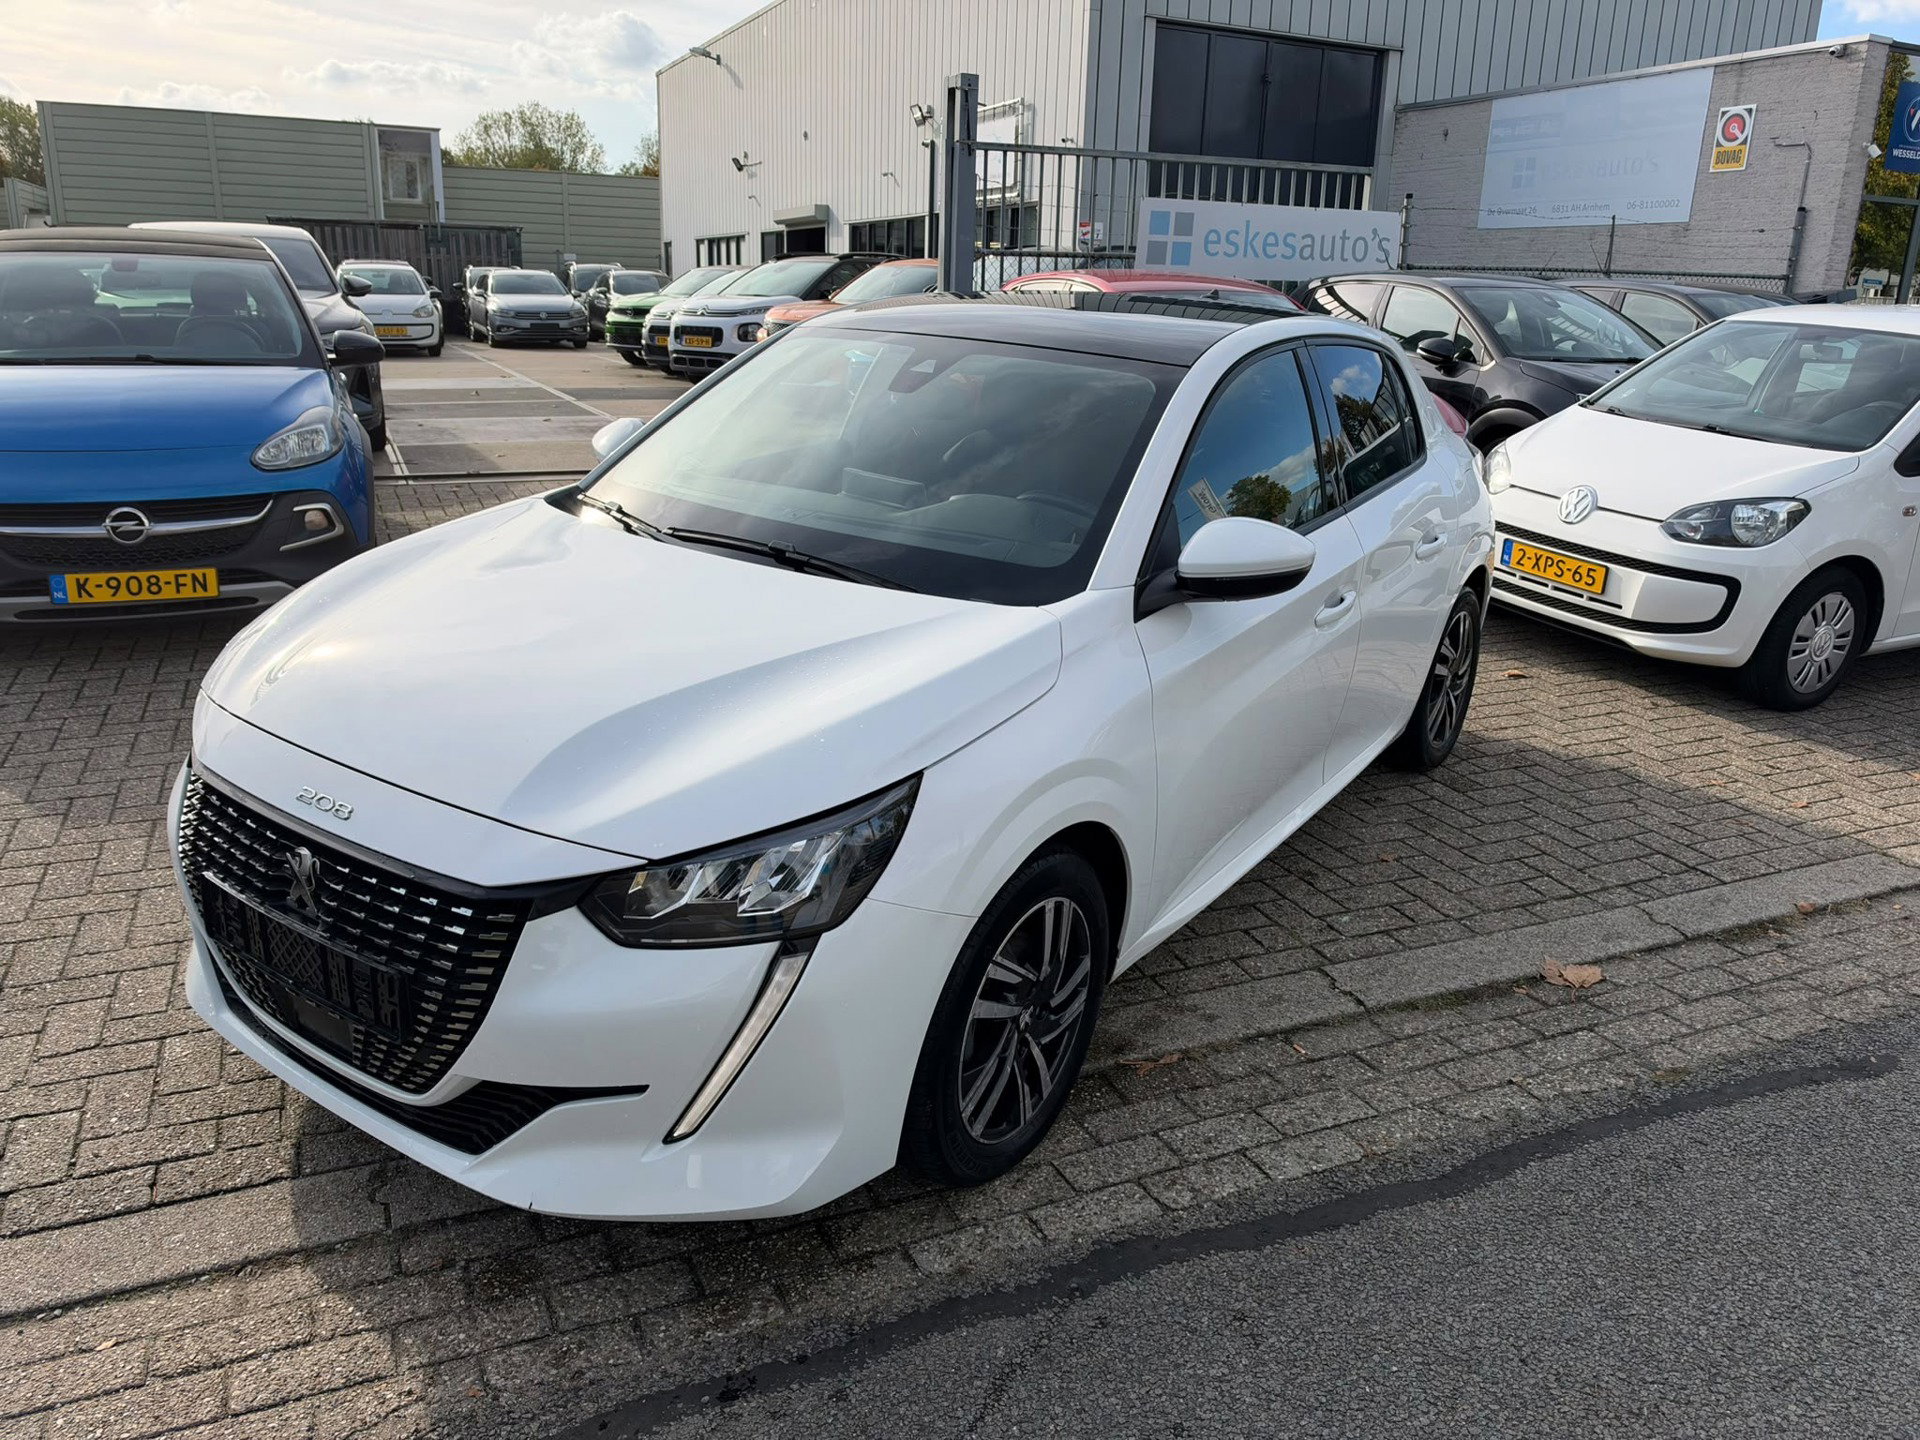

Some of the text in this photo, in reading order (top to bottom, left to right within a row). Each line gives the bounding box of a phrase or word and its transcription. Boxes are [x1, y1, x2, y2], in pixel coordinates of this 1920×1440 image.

[1715, 149, 1743, 165] BOVAG
[1551, 203, 1611, 213] 6831 AH Arnhem
[1626, 199, 1681, 210] 06-81100002
[1203, 220, 1391, 264] eskesauto's
[1516, 548, 1597, 587] 2-XPS-65
[75, 572, 208, 599] K-908-FN
[295, 785, 354, 821] 208
